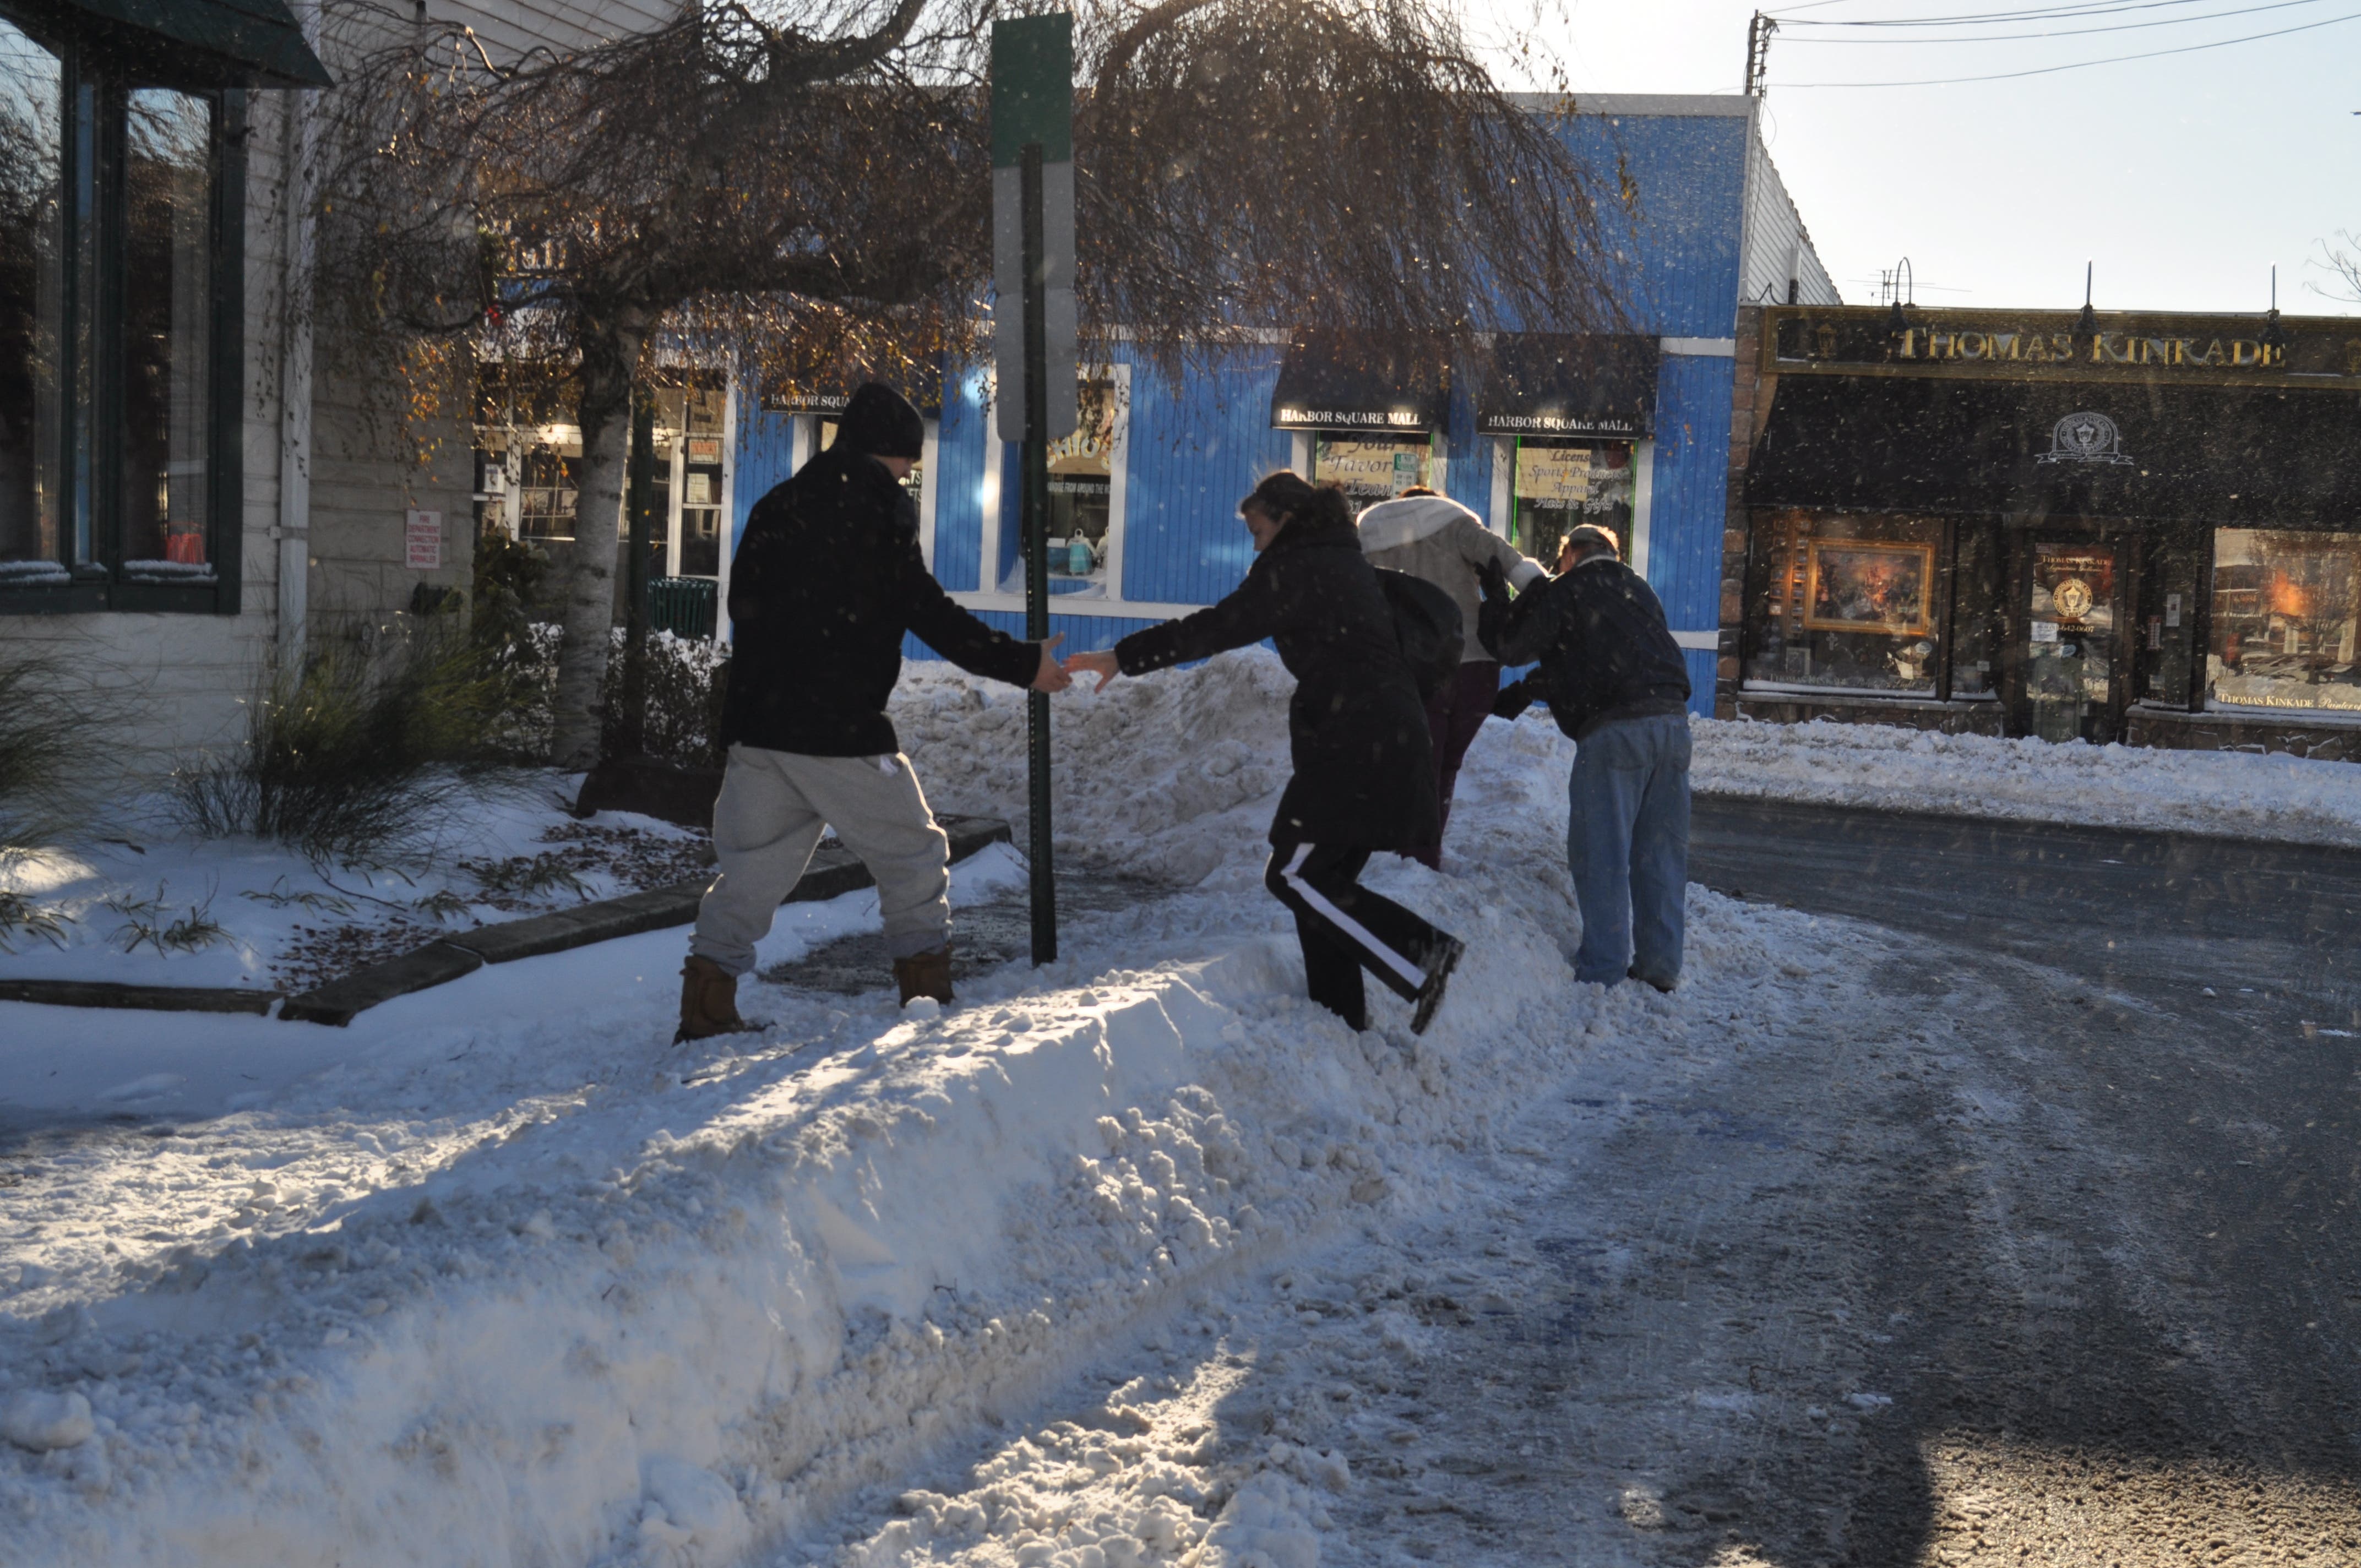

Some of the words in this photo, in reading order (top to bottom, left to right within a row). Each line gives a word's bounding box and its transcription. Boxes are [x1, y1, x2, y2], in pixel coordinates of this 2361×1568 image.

[1892, 328, 2072, 361] THOMAS
[2091, 331, 2286, 368] KINKADE
[821, 396, 851, 408] SQUA
[1281, 409, 1332, 423] HARBOR
[1335, 412, 1384, 424] SQUARE
[1388, 412, 1421, 425] MALL
[1488, 416, 1541, 428] HARBOR
[1543, 417, 1594, 431] SQUARE
[1598, 420, 1633, 432] MALL
[1322, 454, 1392, 473] Favor
[1551, 481, 1602, 496] Apparel
[2219, 694, 2264, 705] THOMAS
[2266, 695, 2314, 708] KINKADE
[2318, 698, 2352, 710] Painter
